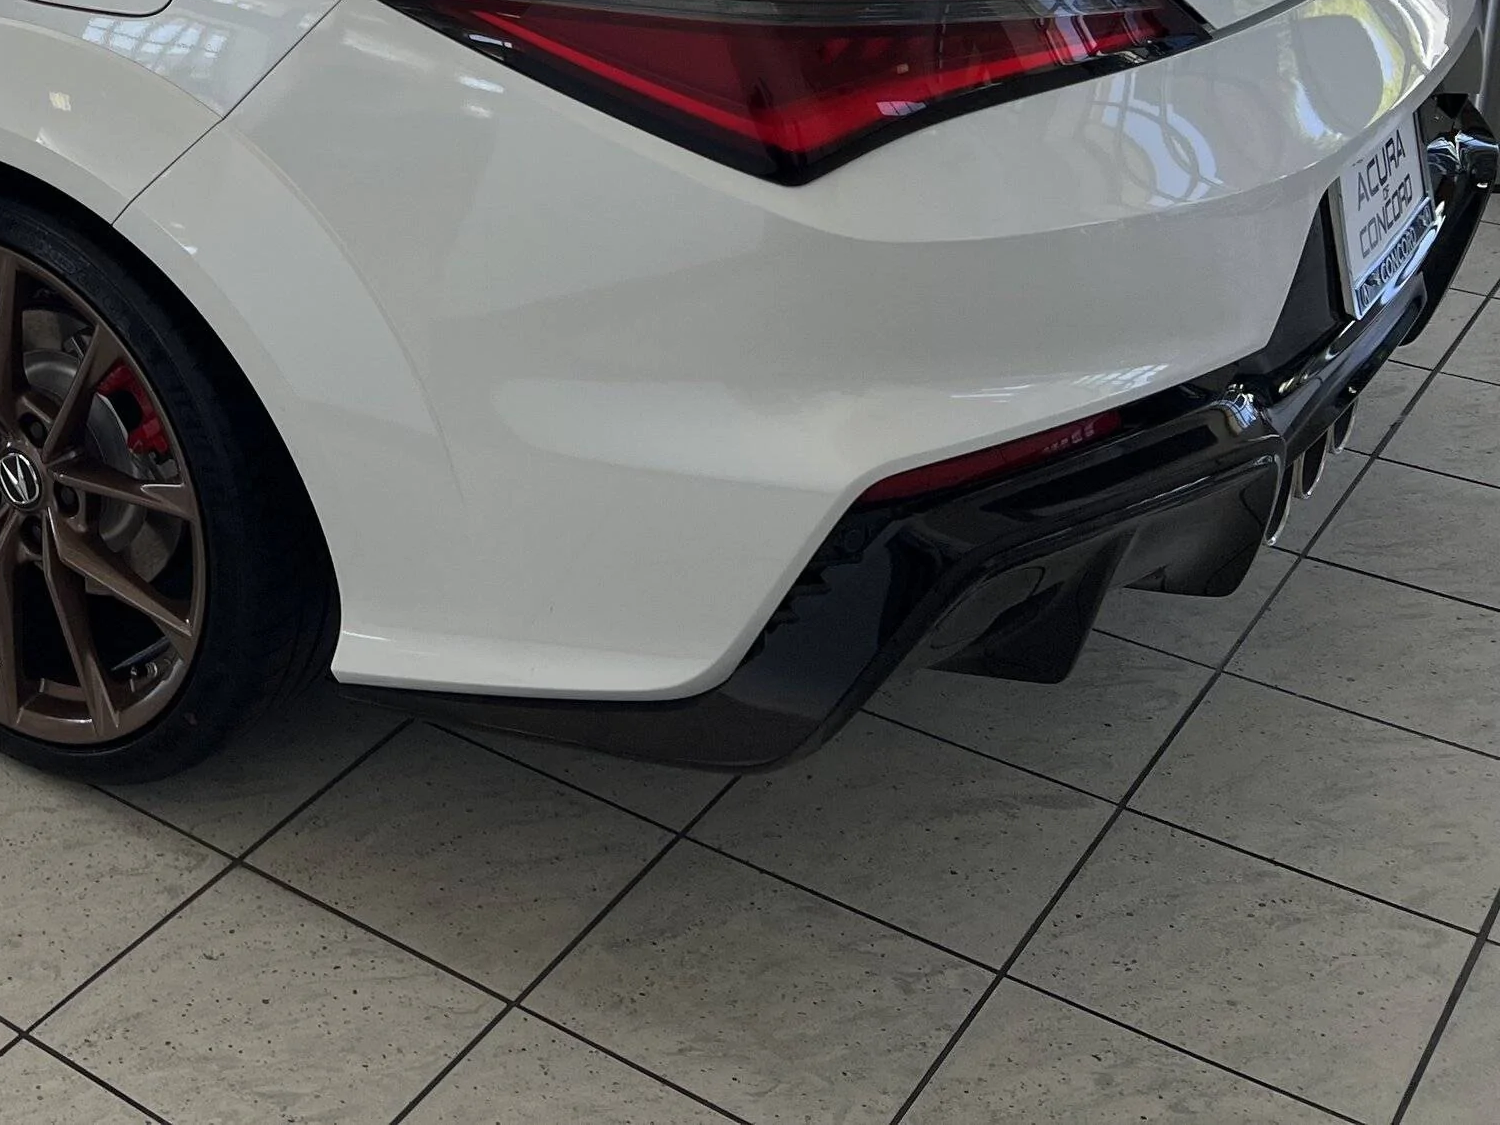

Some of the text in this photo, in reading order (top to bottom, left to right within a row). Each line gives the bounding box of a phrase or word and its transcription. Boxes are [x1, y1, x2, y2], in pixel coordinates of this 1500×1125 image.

[1357, 128, 1406, 212] ACURA
[1358, 173, 1413, 260] CONCORD
[1378, 226, 1418, 285] CONCORD
